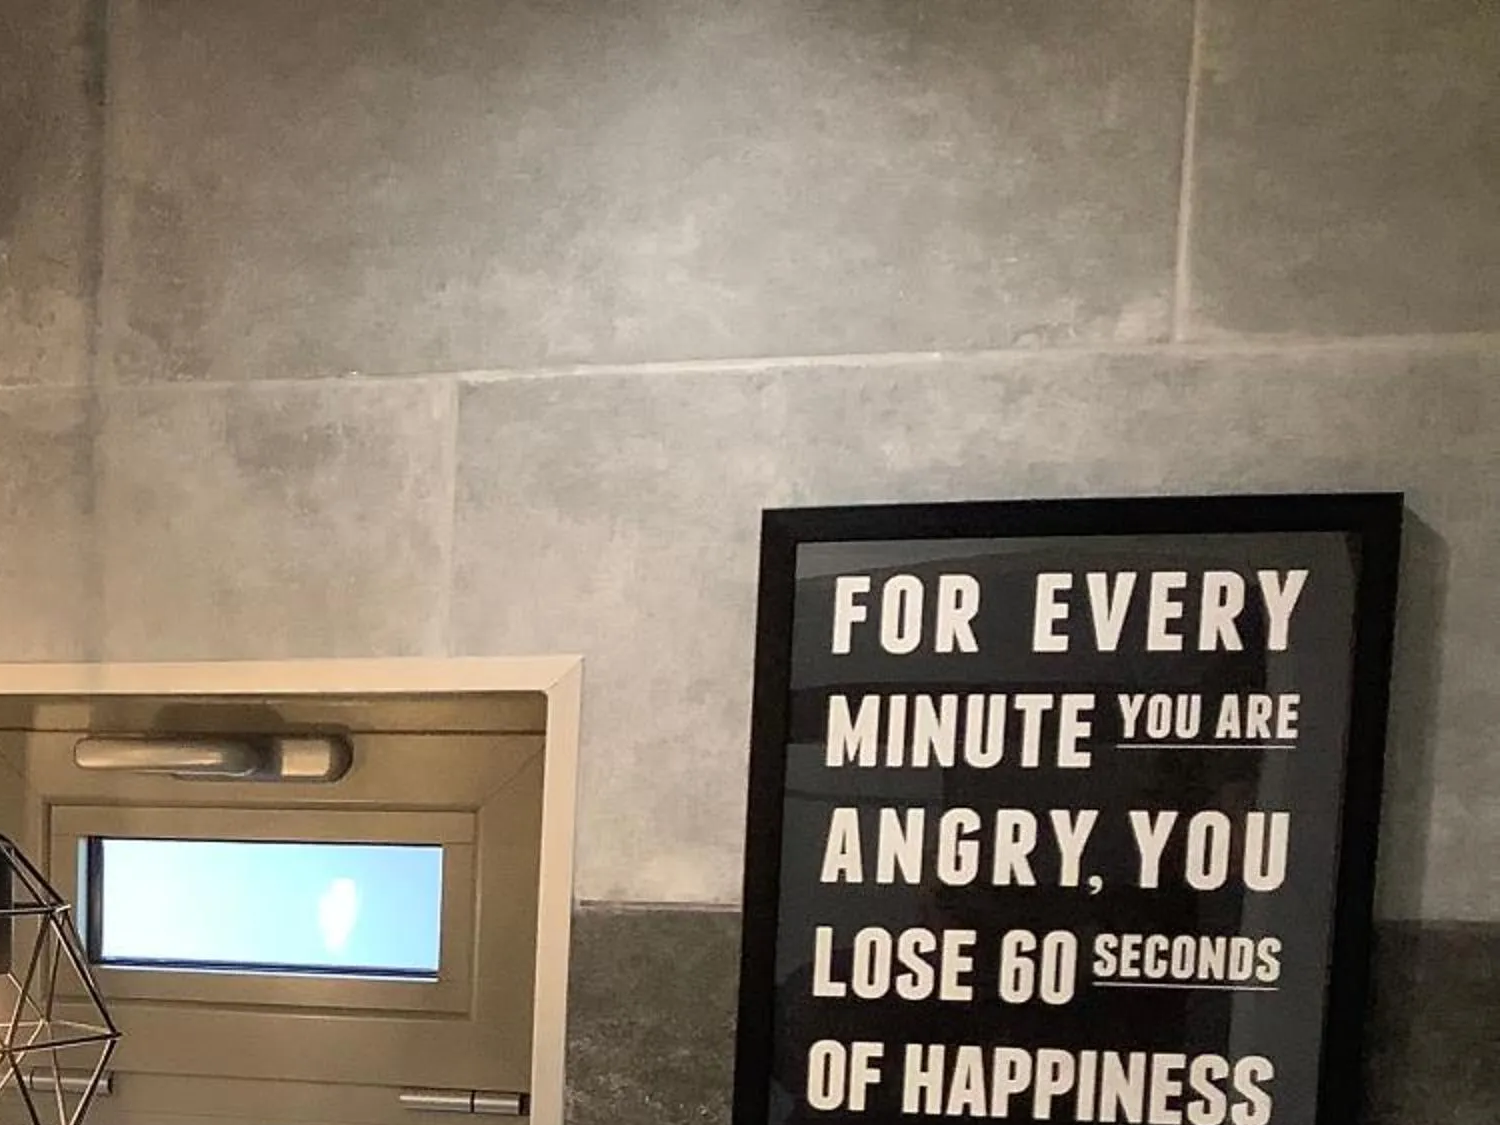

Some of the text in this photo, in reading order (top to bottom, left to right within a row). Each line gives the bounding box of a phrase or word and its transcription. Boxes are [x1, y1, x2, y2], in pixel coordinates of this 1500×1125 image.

[831, 568, 1310, 655] FOR EVERY
[823, 693, 1300, 768] MINUTE YOU ARE
[819, 807, 1292, 896] ANGRY, YOU
[812, 926, 1283, 1005] LOSE 60 SECONDS
[806, 1039, 884, 1112] OF
